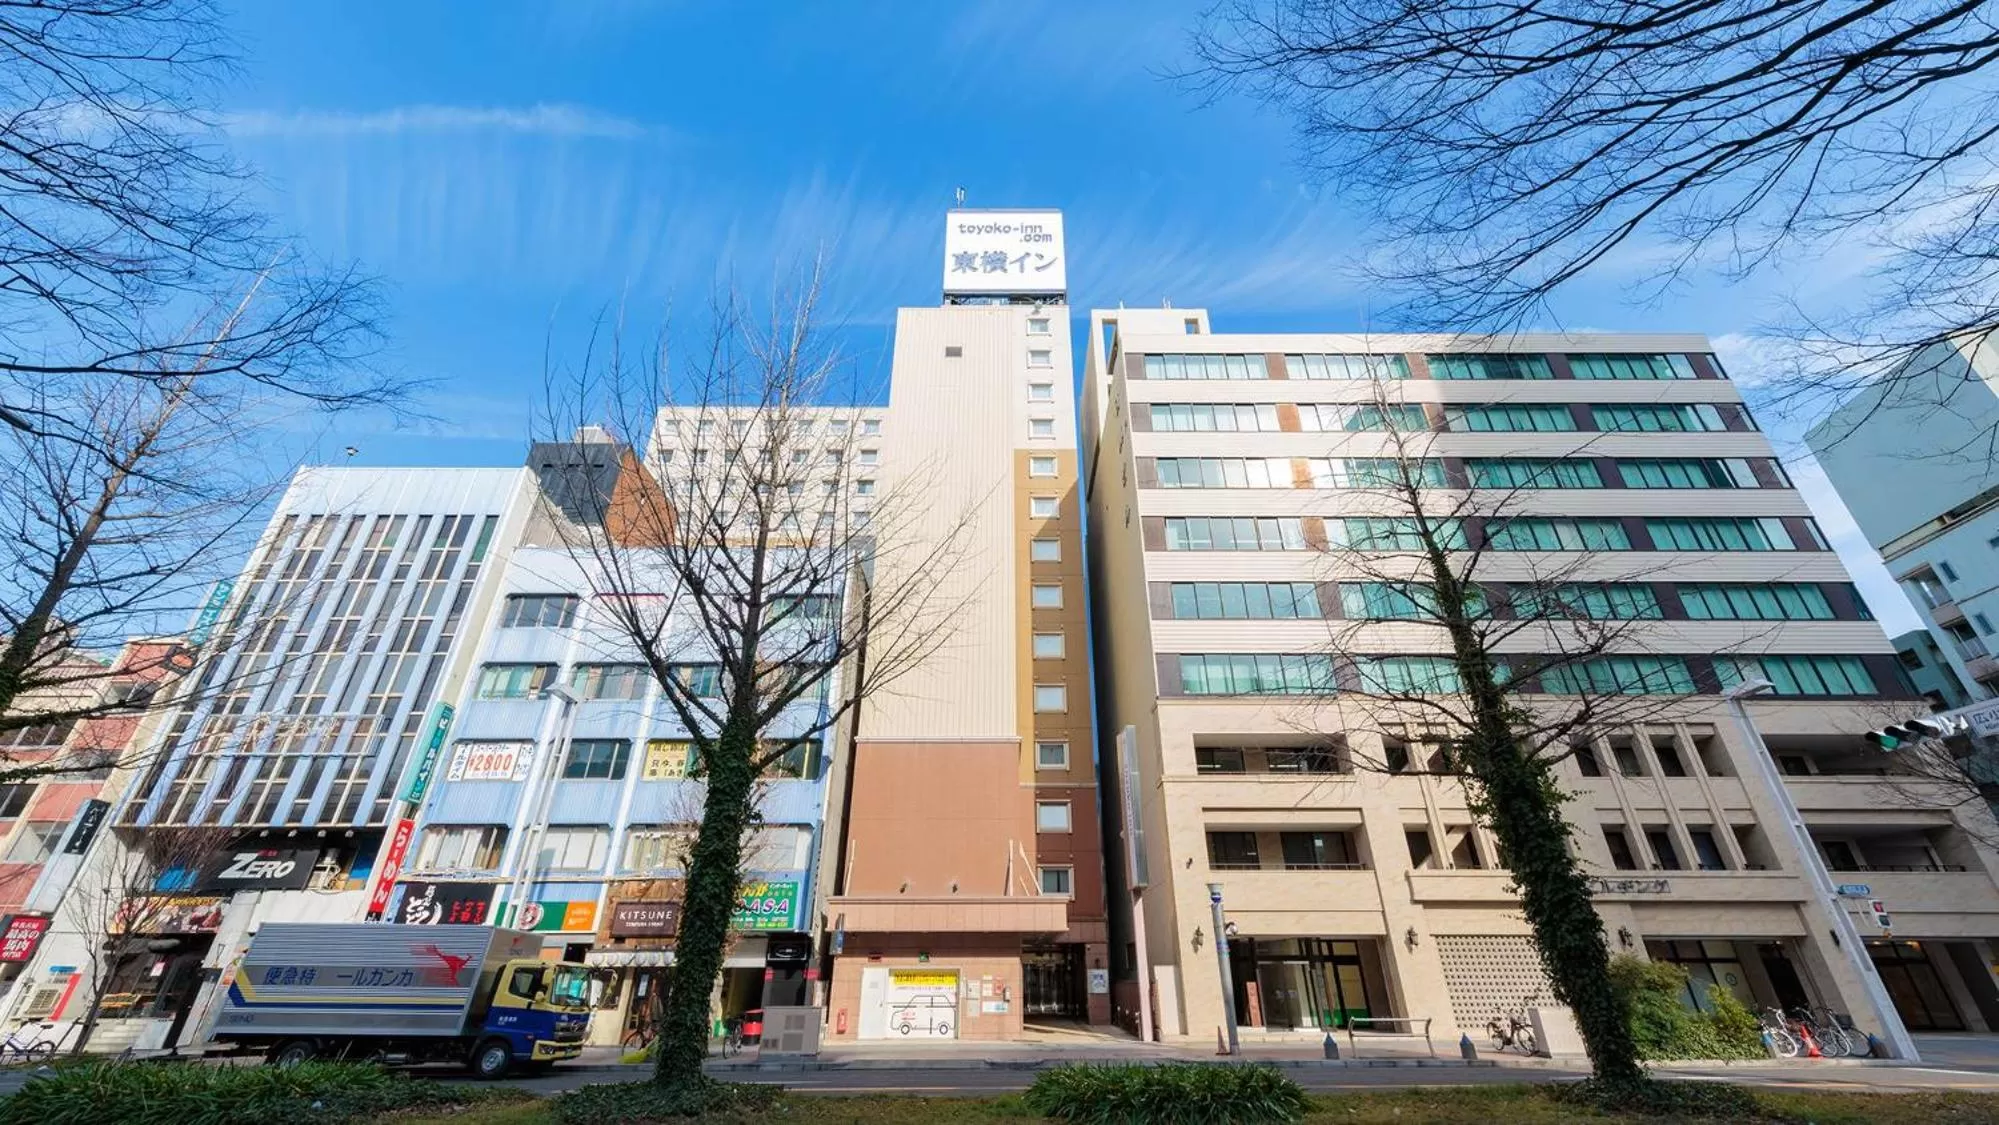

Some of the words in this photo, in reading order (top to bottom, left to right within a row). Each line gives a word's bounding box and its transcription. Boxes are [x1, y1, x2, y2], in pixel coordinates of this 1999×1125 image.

[958, 223, 1043, 235] toyoko-inn
[1020, 233, 1053, 243] .com
[951, 250, 1058, 274] 東横イン
[218, 852, 296, 878] ZERO
[374, 826, 409, 904] らーめん
[619, 910, 673, 920] KITSUNE
